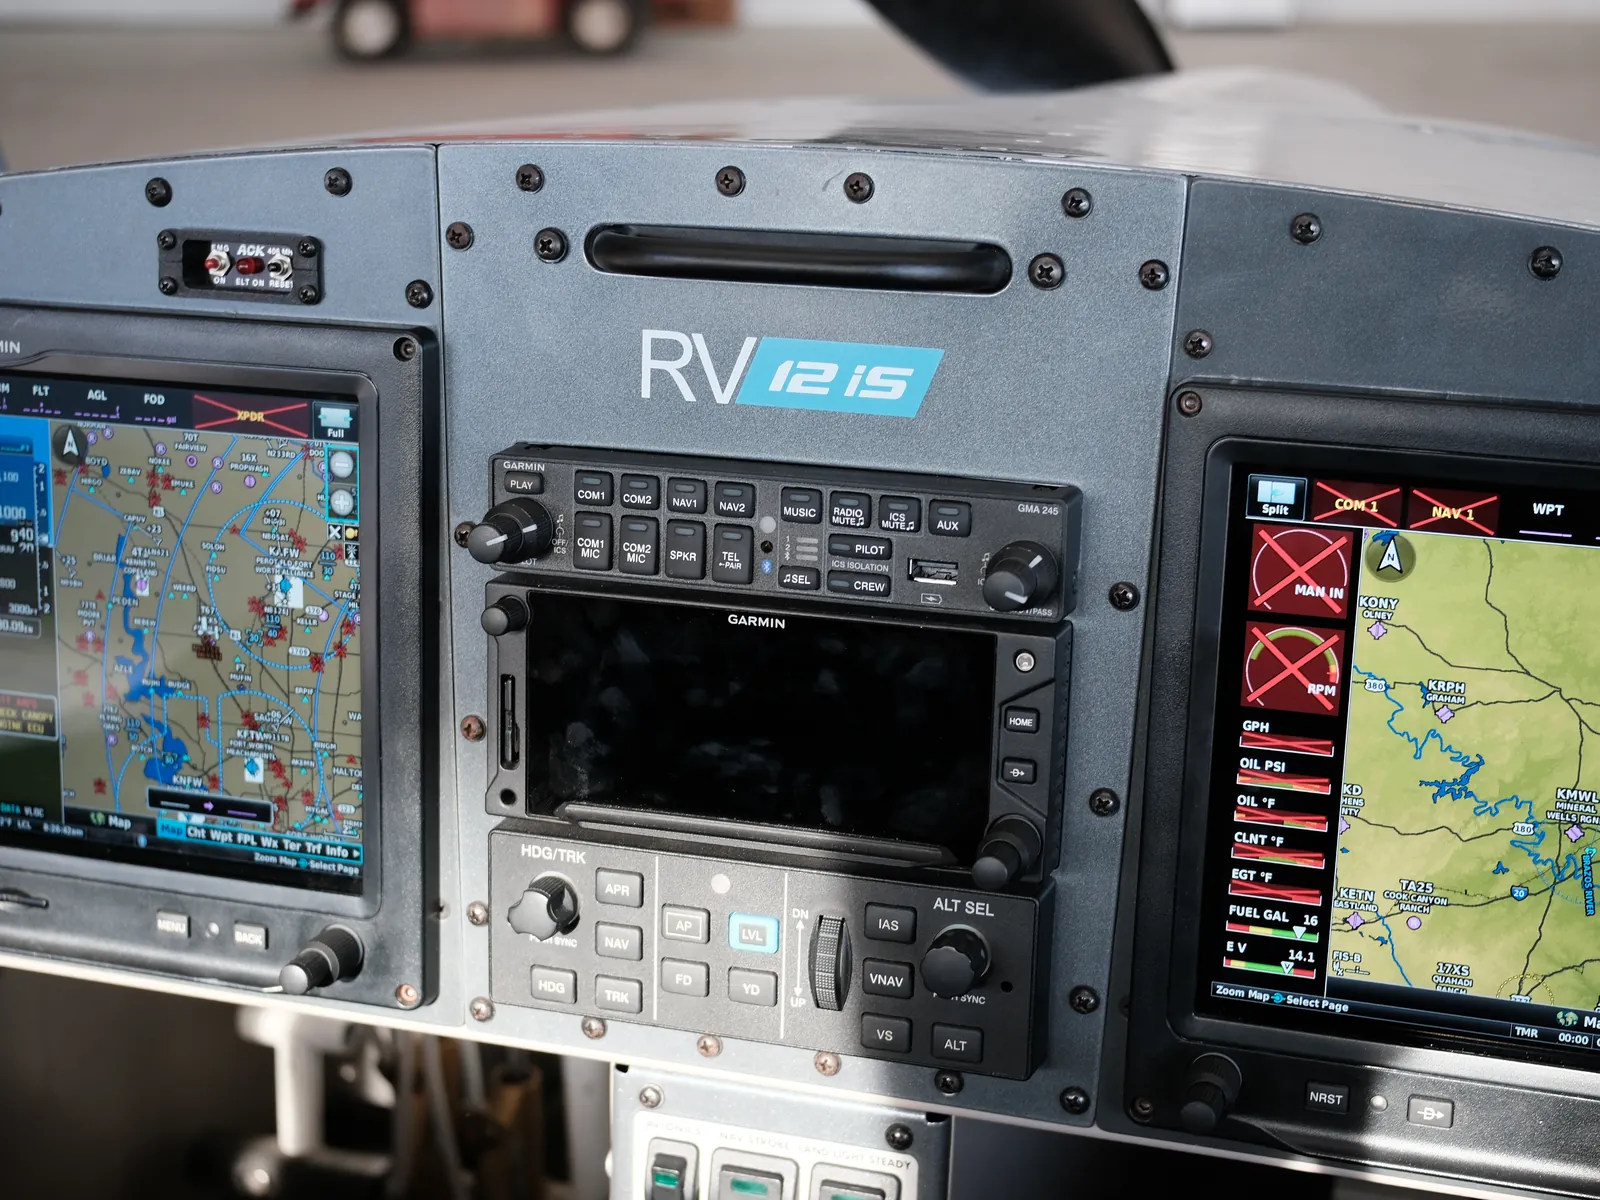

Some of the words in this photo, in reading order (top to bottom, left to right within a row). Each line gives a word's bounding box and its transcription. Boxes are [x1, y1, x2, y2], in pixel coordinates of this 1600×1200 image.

[236, 243, 266, 257] ACK
[213, 277, 226, 285] ON
[235, 277, 249, 286] ELT
[252, 278, 265, 287] ON
[641, 329, 757, 405] RV
[768, 360, 839, 395] 12
[32, 385, 50, 396] FLT
[87, 389, 108, 401] AGL
[144, 393, 165, 405] FOD
[237, 410, 265, 422] XPDR
[184, 432, 199, 442] 70T
[327, 429, 345, 438] Full
[174, 442, 207, 453] FAIRVIEW
[85, 456, 108, 466] BOYD
[241, 452, 257, 462] 16X
[230, 463, 269, 473] PROPWASH
[503, 461, 545, 472] GARMIN
[510, 480, 534, 490] PLAY
[577, 490, 605, 501] COM1
[623, 494, 652, 505] COM2
[672, 498, 698, 508] NAV1
[719, 502, 746, 513] NAV2
[1335, 498, 1366, 512] COM
[1370, 501, 1379, 513] 1
[1532, 502, 1565, 516] WPT
[783, 506, 817, 518] MUSIC
[833, 507, 863, 518] RADIO
[1017, 504, 1041, 514] GMA
[1042, 505, 1059, 516] 245
[1262, 503, 1289, 516] Split
[1432, 506, 1462, 519] NAV
[1466, 509, 1475, 521] 1
[832, 516, 856, 526] MUTE
[889, 512, 906, 522] ICS
[881, 520, 906, 530] MUTE
[936, 520, 959, 531] AUX
[577, 537, 605, 549] COM1
[622, 542, 652, 554] COM2
[553, 546, 567, 555] ICS
[581, 548, 600, 559] MIC
[855, 544, 885, 555] PILOT
[256, 557, 278, 566] PEROT
[320, 551, 336, 561] 110
[626, 552, 646, 564] MIC
[669, 550, 697, 562] SPKR
[722, 551, 740, 562] TEL
[125, 558, 156, 568] KENNETH
[724, 561, 742, 570] PAIR
[831, 560, 846, 569] ICS
[847, 560, 889, 572] ISOLATION
[123, 567, 158, 577] COPELAND
[791, 574, 811, 585] SEL
[853, 581, 886, 592] CREW
[1295, 584, 1326, 598] MAN
[1329, 587, 1344, 599] IN
[112, 597, 139, 607] PEDEN
[1358, 595, 1399, 610] KONY
[1362, 610, 1394, 621] OLNEY
[728, 614, 786, 630] GARMIN
[1307, 683, 1337, 697] RPM
[1367, 681, 1384, 691] 380
[1428, 680, 1466, 694] KRPH
[1426, 693, 1466, 705] GRAHAM
[1009, 716, 1034, 728] HOME
[1242, 720, 1270, 733] GPH
[1239, 757, 1261, 770] OIL
[1264, 760, 1286, 773] PSI
[1556, 787, 1600, 803] KMWL
[1236, 794, 1258, 807] OIL
[1262, 797, 1276, 809] °F
[1555, 802, 1597, 814] MINERAL
[108, 815, 132, 829] Map
[1546, 811, 1577, 823] WELLS
[1580, 815, 1600, 825] RGN
[1515, 825, 1532, 834] 180
[160, 823, 183, 837] Map
[187, 825, 206, 839] Cht
[210, 827, 233, 843] Wpt
[237, 832, 258, 846] FPL
[261, 836, 279, 849] Wx
[282, 839, 302, 852] Ter
[305, 841, 322, 854] Trf
[326, 844, 349, 858] Info
[1234, 832, 1268, 846] CLNT
[1271, 836, 1285, 847] °F
[521, 843, 587, 864] HDG/TRK
[254, 852, 278, 863] Zoom
[280, 855, 298, 868] Map
[309, 860, 336, 872] Select
[337, 863, 360, 876] Page
[1231, 868, 1257, 881] EGT
[1260, 872, 1273, 883] °F
[1582, 854, 1594, 892] BRAZOS
[605, 884, 630, 896] APR
[1400, 879, 1434, 894] TA25
[1339, 887, 1376, 902] KETN
[1383, 890, 1409, 901] COOK
[1409, 894, 1449, 907] CANYON
[1513, 889, 1525, 898] 20
[933, 897, 961, 912] ALT
[964, 901, 995, 917] SEL
[1333, 900, 1379, 913] EASTLAND
[1399, 903, 1431, 915] RANCH
[1585, 892, 1596, 916] RIVER
[792, 908, 809, 920] DN
[1229, 904, 1261, 919] FUEL
[1263, 909, 1290, 922] GAL
[1303, 914, 1319, 927] 16
[675, 920, 693, 932] AP
[878, 918, 899, 931] IAS
[742, 929, 764, 942] LVL
[554, 938, 578, 948] SYNC
[604, 936, 630, 950] NAV
[1226, 941, 1235, 952] E
[1238, 942, 1248, 953] V
[1288, 949, 1316, 963] 14.1
[1332, 950, 1362, 963] FIS-B
[1436, 962, 1470, 977] 17XS
[675, 973, 693, 986] FD
[869, 973, 904, 987] VNAV
[1432, 974, 1474, 988] QUAHADI
[538, 980, 566, 994] HDG
[742, 983, 761, 996] YD
[604, 990, 630, 1004] TRK
[790, 997, 807, 1008] UP
[960, 994, 986, 1005] SYNC
[1216, 985, 1245, 998] Zoom
[1248, 988, 1270, 1002] Map
[1286, 995, 1320, 1009] Select
[1321, 999, 1349, 1013] Page
[876, 1029, 893, 1041] VS
[1514, 1026, 1539, 1039] TMR
[1558, 1032, 1589, 1045] 00:00
[944, 1039, 967, 1052] ALT
[1309, 1090, 1344, 1106] NRST
[868, 1154, 913, 1170] STEADY
